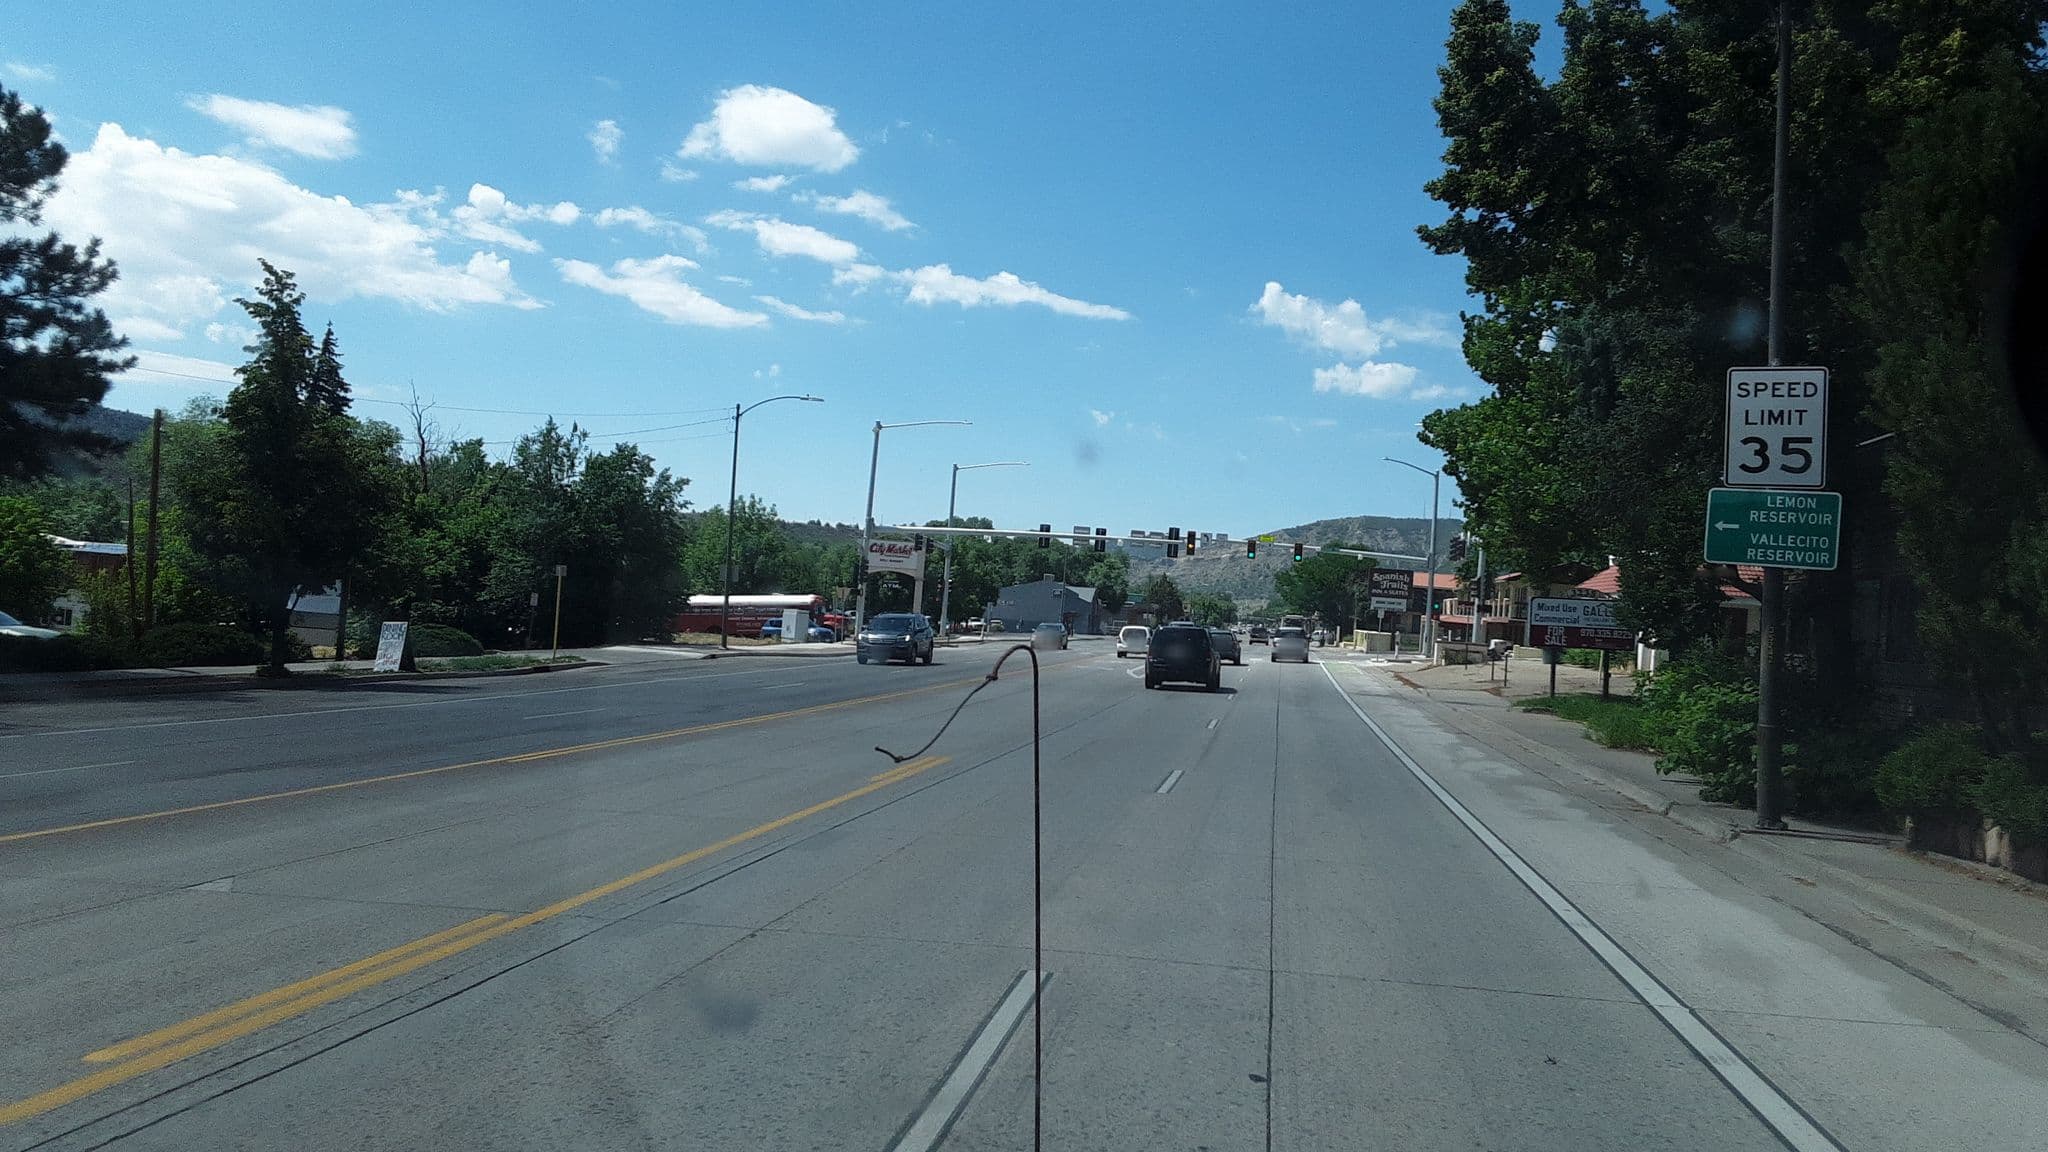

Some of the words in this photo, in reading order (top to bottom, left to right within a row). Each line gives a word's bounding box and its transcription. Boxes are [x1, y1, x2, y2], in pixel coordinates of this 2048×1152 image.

[1737, 382, 1818, 398] SPEED
[1744, 409, 1808, 426] LIMIT
[1739, 436, 1813, 474] 35
[1767, 496, 1817, 508] LEMON
[1749, 510, 1832, 525] RESERVOIR
[1750, 533, 1829, 548] VALLECITO
[870, 542, 885, 556] City
[885, 543, 913, 556] Market
[1747, 548, 1830, 564] RESERVOIR
[1372, 572, 1410, 583] Spanish
[1380, 580, 1409, 591] Trails
[1537, 602, 1560, 613] Mixed
[1562, 603, 1577, 613] Use
[1534, 613, 1580, 625] Commercial
[1547, 626, 1566, 637] FOR
[1544, 634, 1568, 646] SALE
